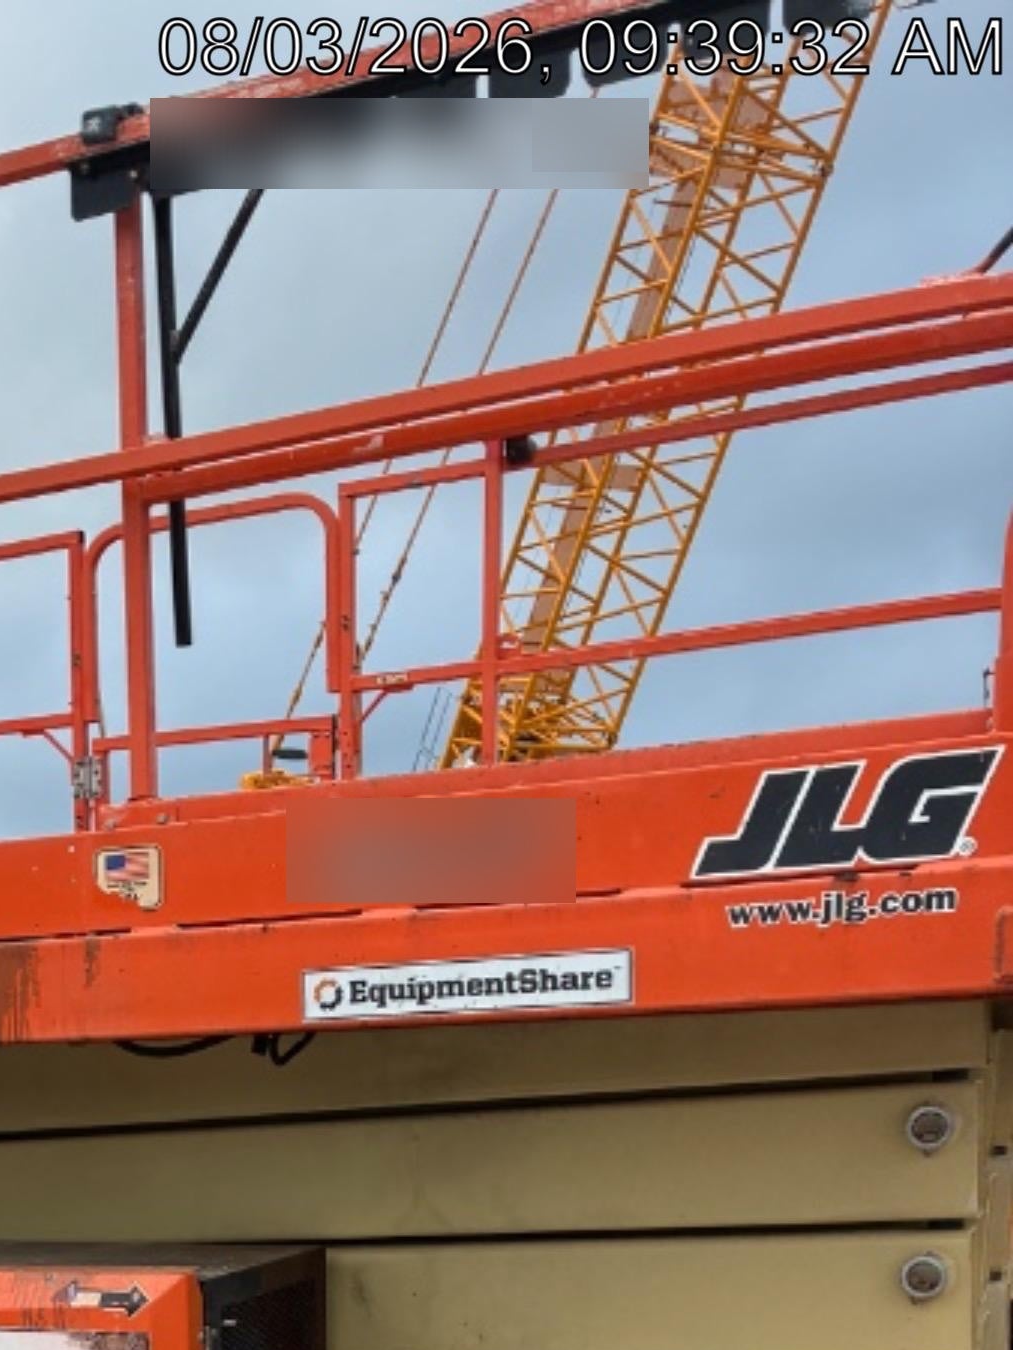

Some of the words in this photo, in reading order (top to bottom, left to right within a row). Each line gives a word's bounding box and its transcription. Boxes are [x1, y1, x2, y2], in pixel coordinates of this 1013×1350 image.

[690, 745, 1004, 881] JLG
[727, 888, 958, 926] www.jlg.com
[349, 967, 613, 1008] EquipmentShare
